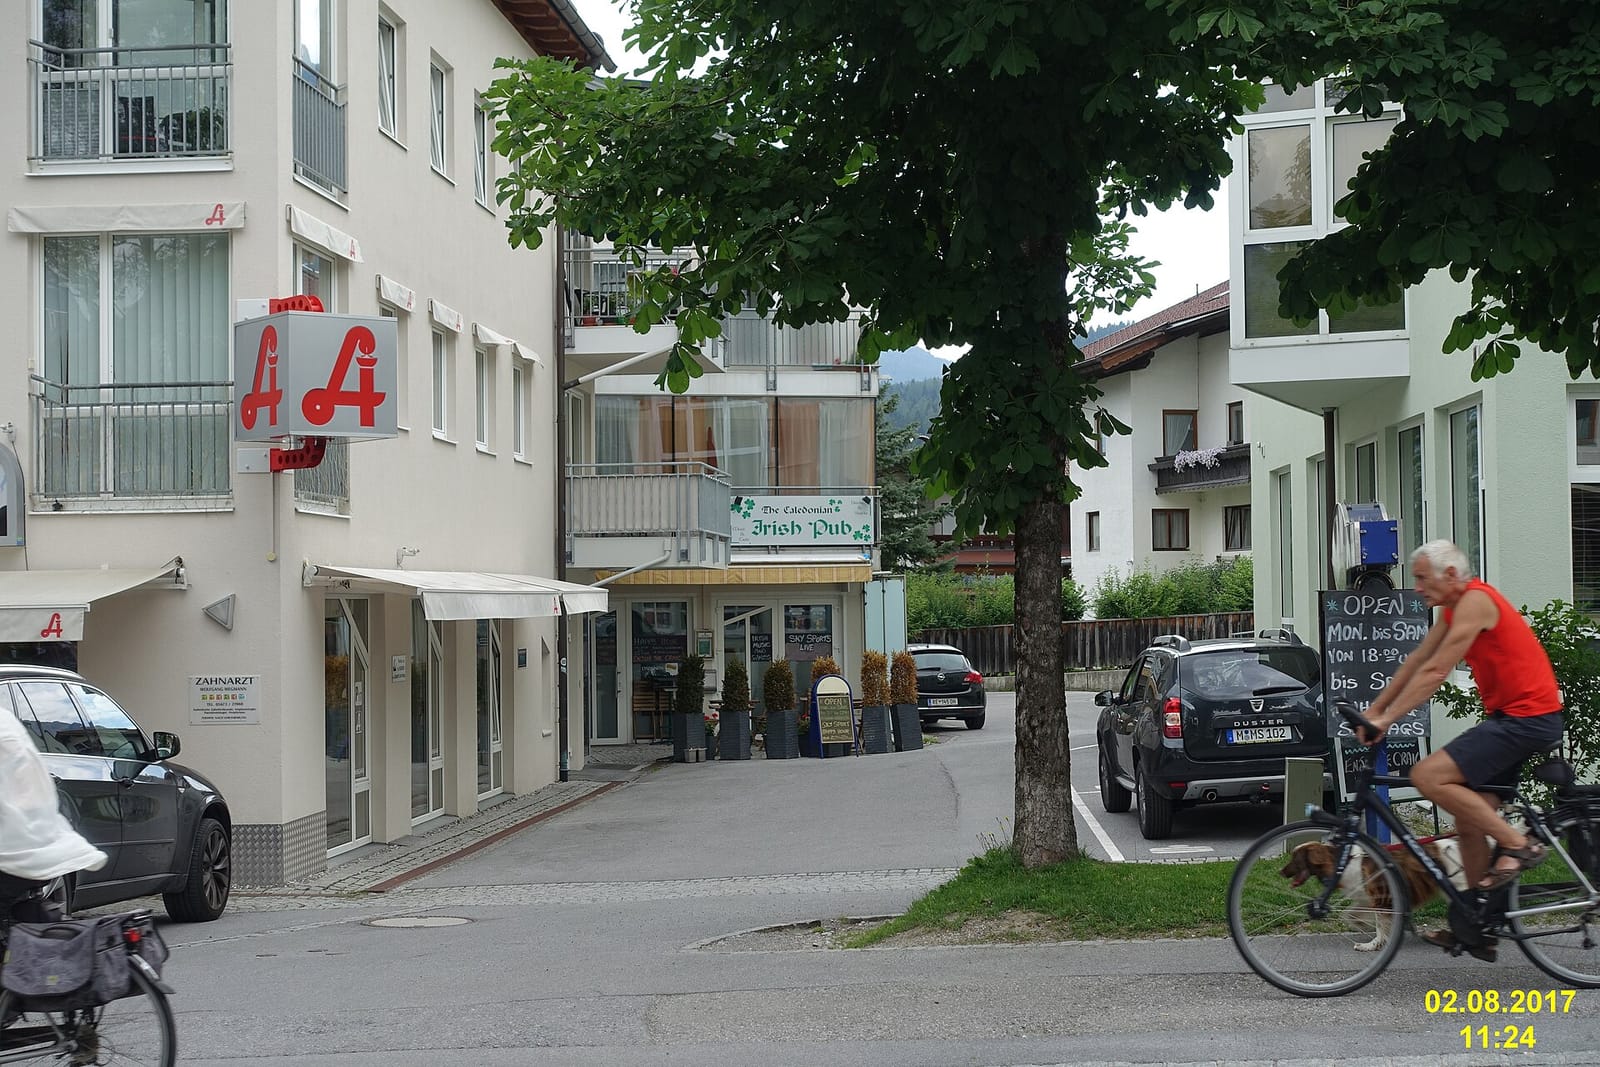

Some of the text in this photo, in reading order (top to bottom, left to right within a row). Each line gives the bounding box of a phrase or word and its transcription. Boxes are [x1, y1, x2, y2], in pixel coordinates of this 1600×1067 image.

[761, 505, 833, 514] The Caledonian
[751, 519, 852, 539] Irish Pub
[1343, 592, 1404, 616] OPEN
[788, 634, 832, 643] SKY SPORTS
[1327, 622, 1368, 643] MON.
[1372, 626, 1392, 641] bis
[799, 643, 814, 651] LIVE
[1327, 648, 1354, 664] VON
[195, 676, 254, 686] ZAHNARZT
[1330, 672, 1358, 690] bis
[1233, 718, 1284, 727] DUSTER
[1236, 727, 1286, 740] M MS 102
